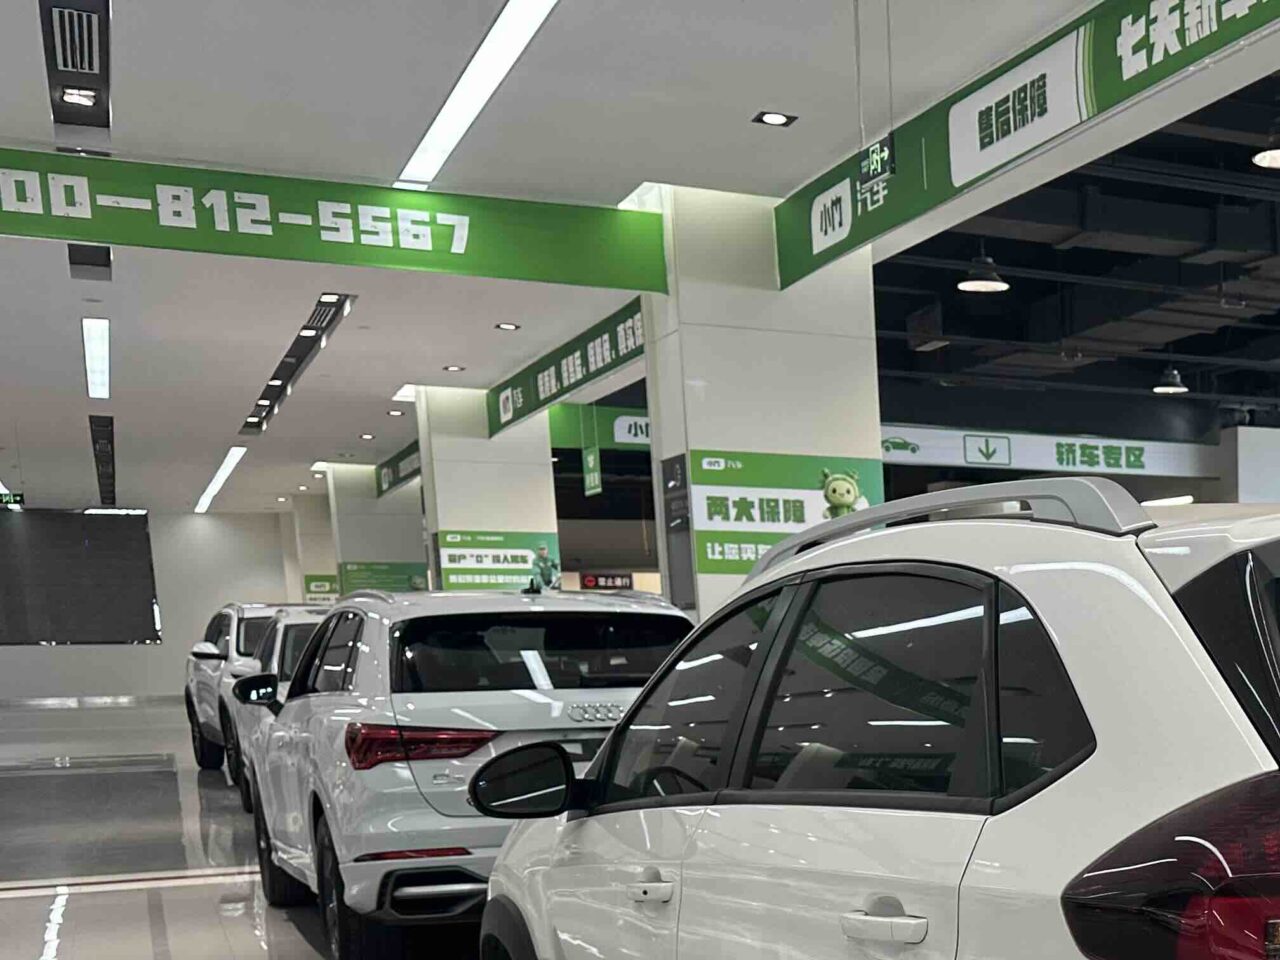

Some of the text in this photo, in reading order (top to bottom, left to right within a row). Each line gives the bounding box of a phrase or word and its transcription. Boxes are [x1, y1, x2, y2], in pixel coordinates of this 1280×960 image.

[977, 73, 1048, 151] 售后保障
[1056, 442, 1145, 469] 轿车专区
[706, 495, 806, 523] 两大保障
